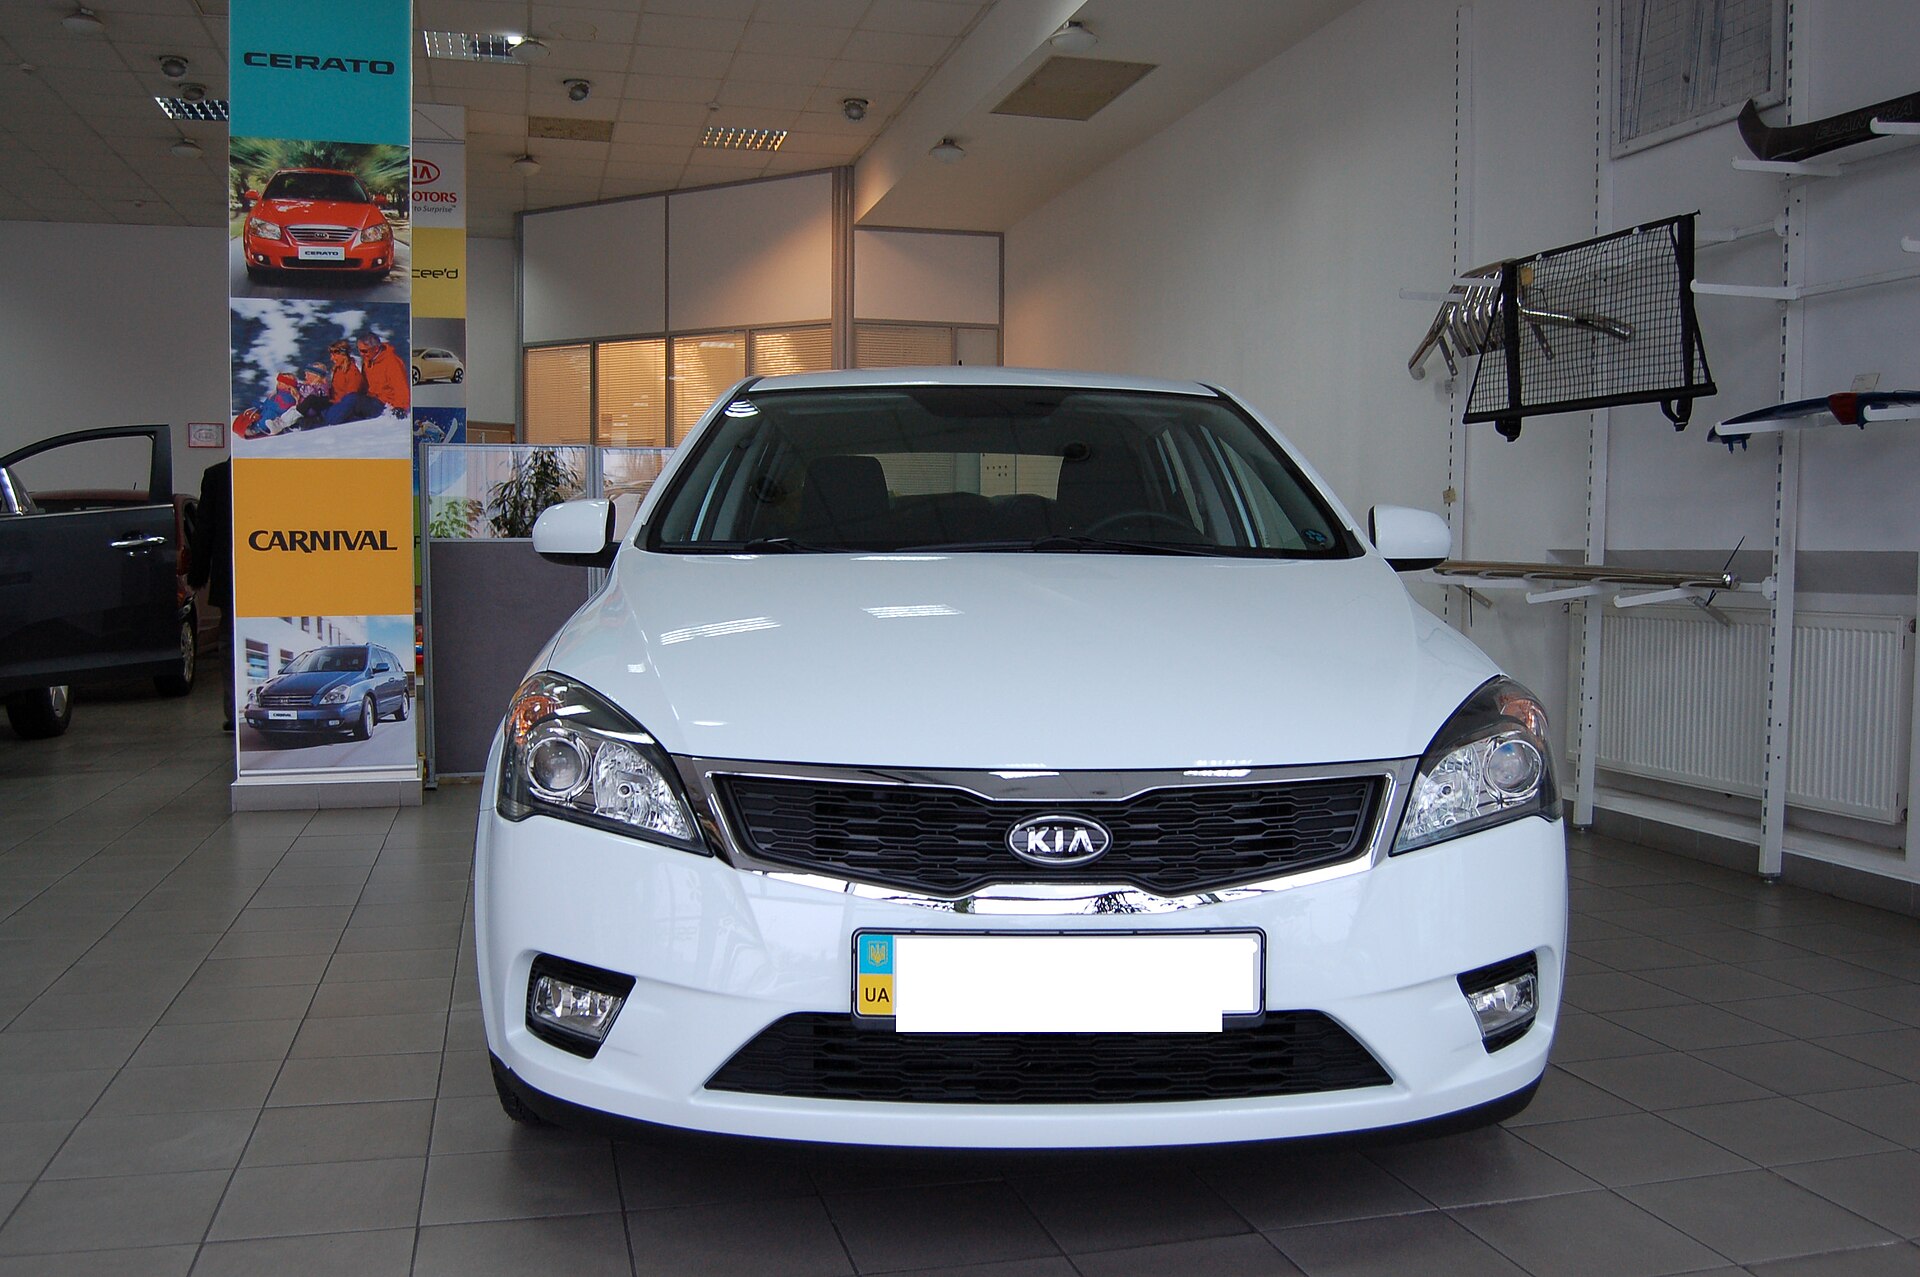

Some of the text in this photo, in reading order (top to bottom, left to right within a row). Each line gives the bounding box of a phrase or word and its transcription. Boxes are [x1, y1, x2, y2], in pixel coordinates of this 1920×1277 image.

[243, 52, 395, 75] CERATO
[412, 166, 432, 179] IA
[412, 191, 457, 203] OTORS
[248, 530, 398, 553] CARNIVAL
[1026, 826, 1094, 853] KIA
[865, 987, 890, 1002] UA
